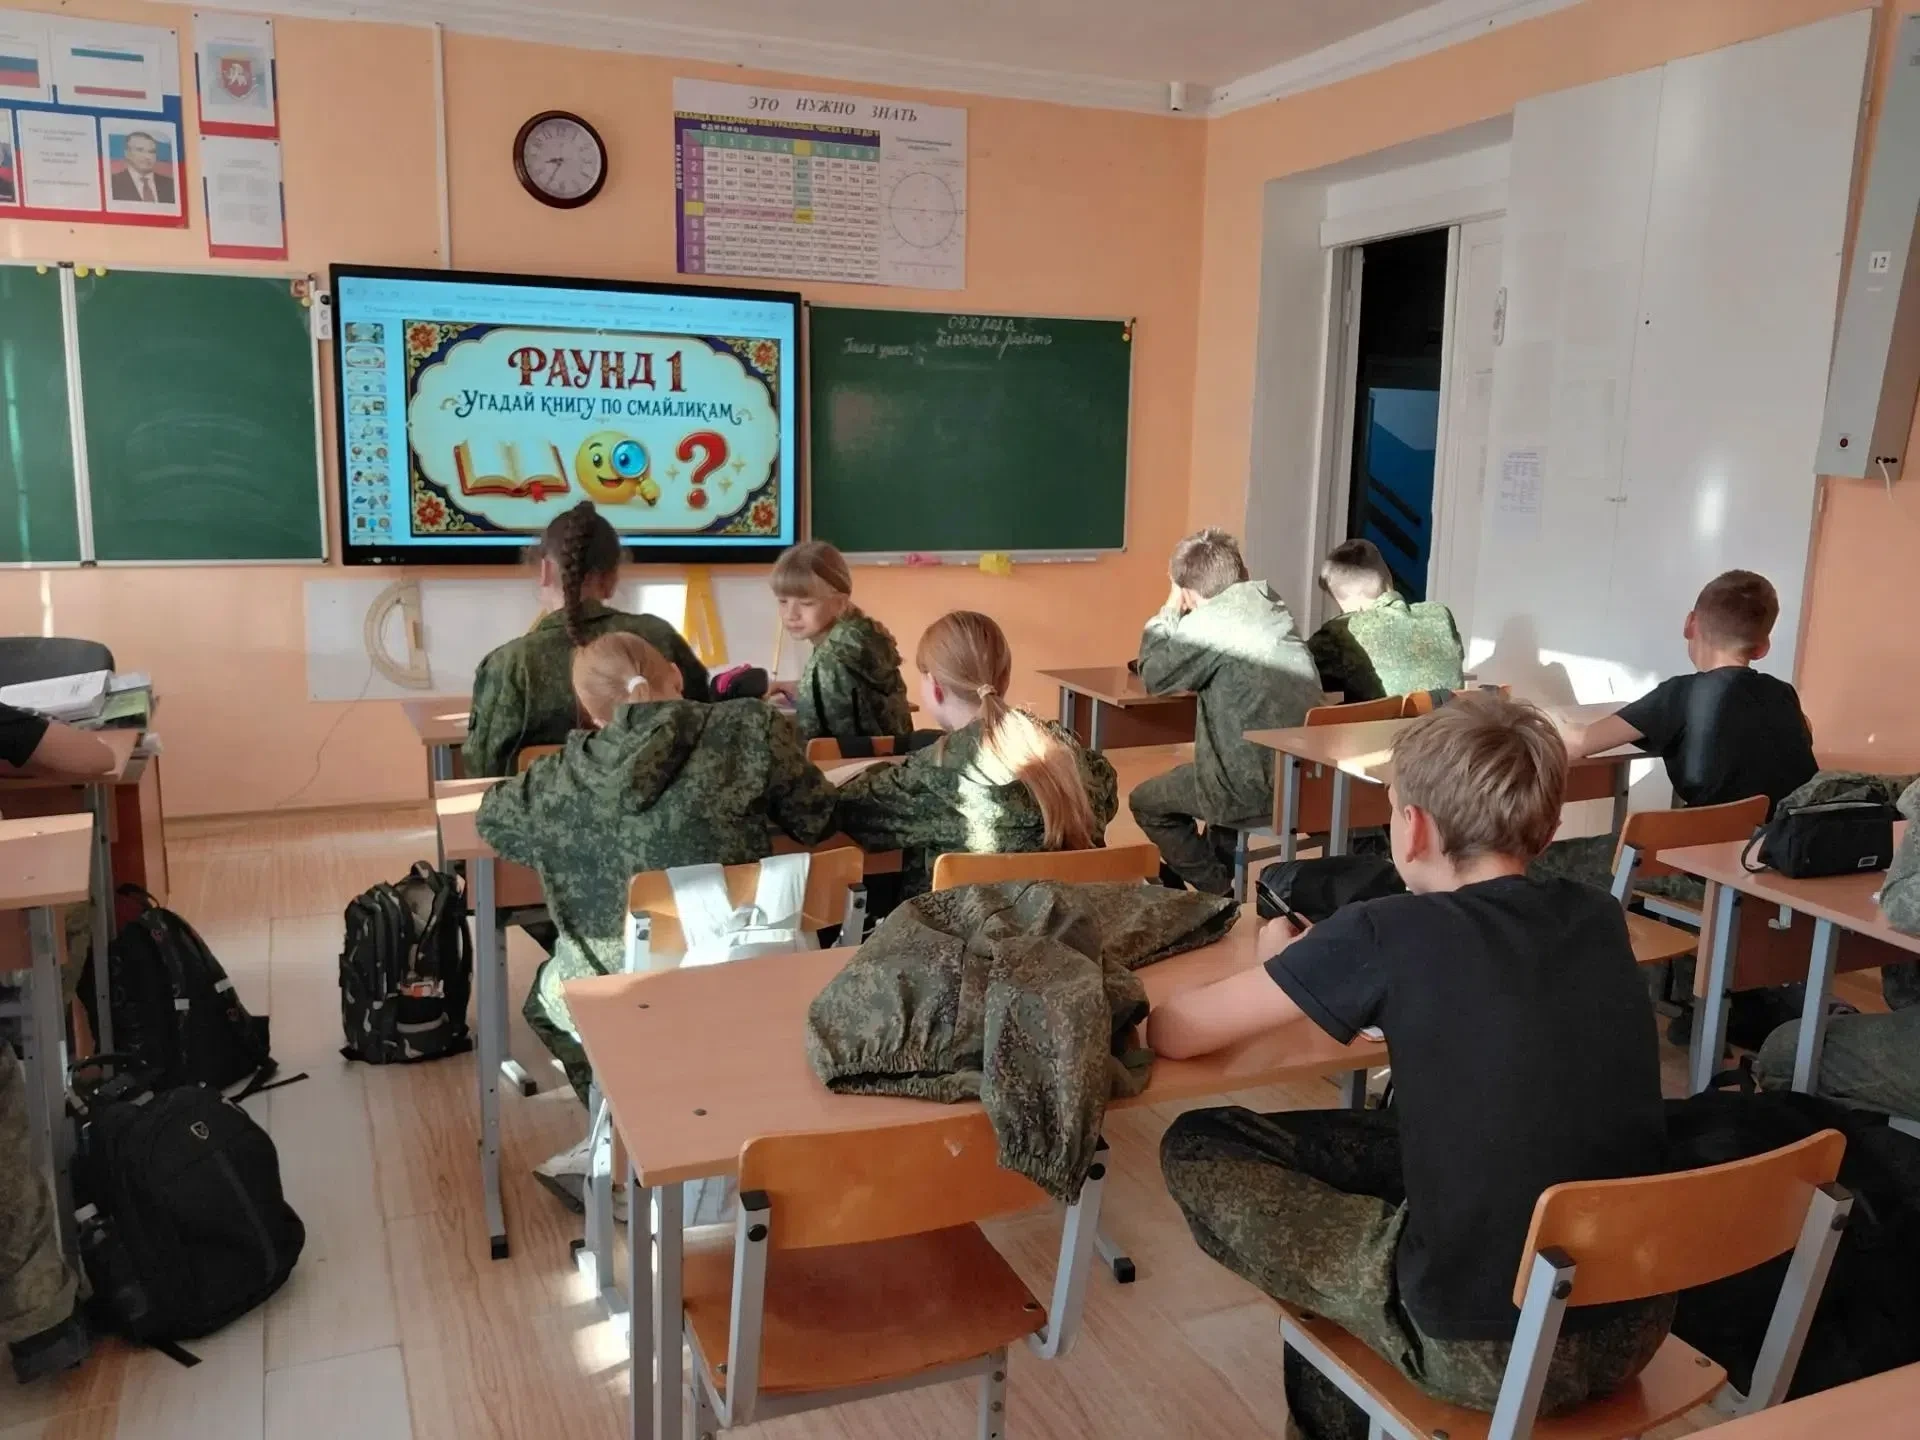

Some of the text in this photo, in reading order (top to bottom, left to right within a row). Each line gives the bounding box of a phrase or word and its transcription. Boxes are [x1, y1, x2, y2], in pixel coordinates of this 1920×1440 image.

[748, 96, 918, 122] ЭТО НУЖНО ЗНАТЬ
[1873, 257, 1887, 269] 12
[507, 347, 687, 393] РАУНД 1
[541, 394, 595, 421] КНИГУ
[601, 398, 622, 415] ПО
[627, 397, 743, 425] СМАЙЛИКАМ
